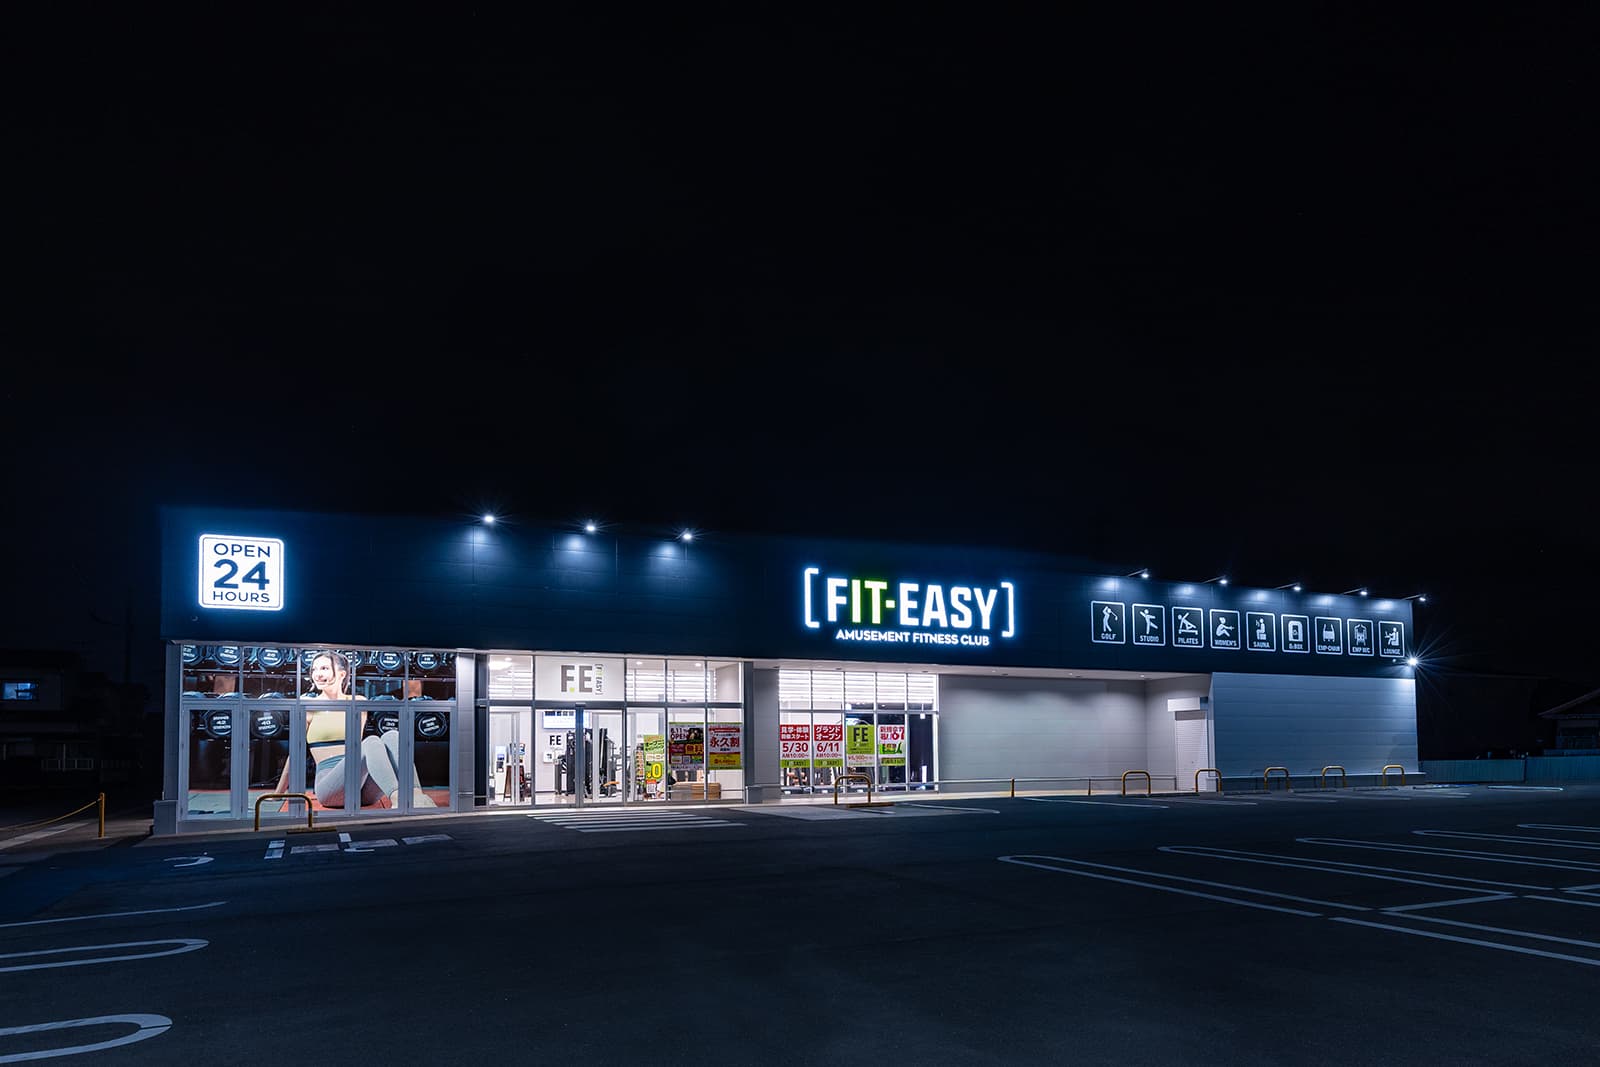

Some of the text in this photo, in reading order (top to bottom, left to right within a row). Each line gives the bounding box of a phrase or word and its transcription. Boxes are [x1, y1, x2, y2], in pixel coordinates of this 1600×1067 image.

[213, 543, 270, 557] OPEN
[213, 559, 270, 590] 24
[213, 591, 270, 603] HOURS
[835, 629, 990, 646] AMUSEMENT FITNESS CLUB
[1101, 633, 1116, 641] GOLF
[1140, 635, 1159, 643] STUDIO
[1178, 637, 1199, 645] PILATES
[710, 736, 740, 747] 永久割
[782, 742, 809, 752] 5/30
[816, 742, 840, 752] 6/11
